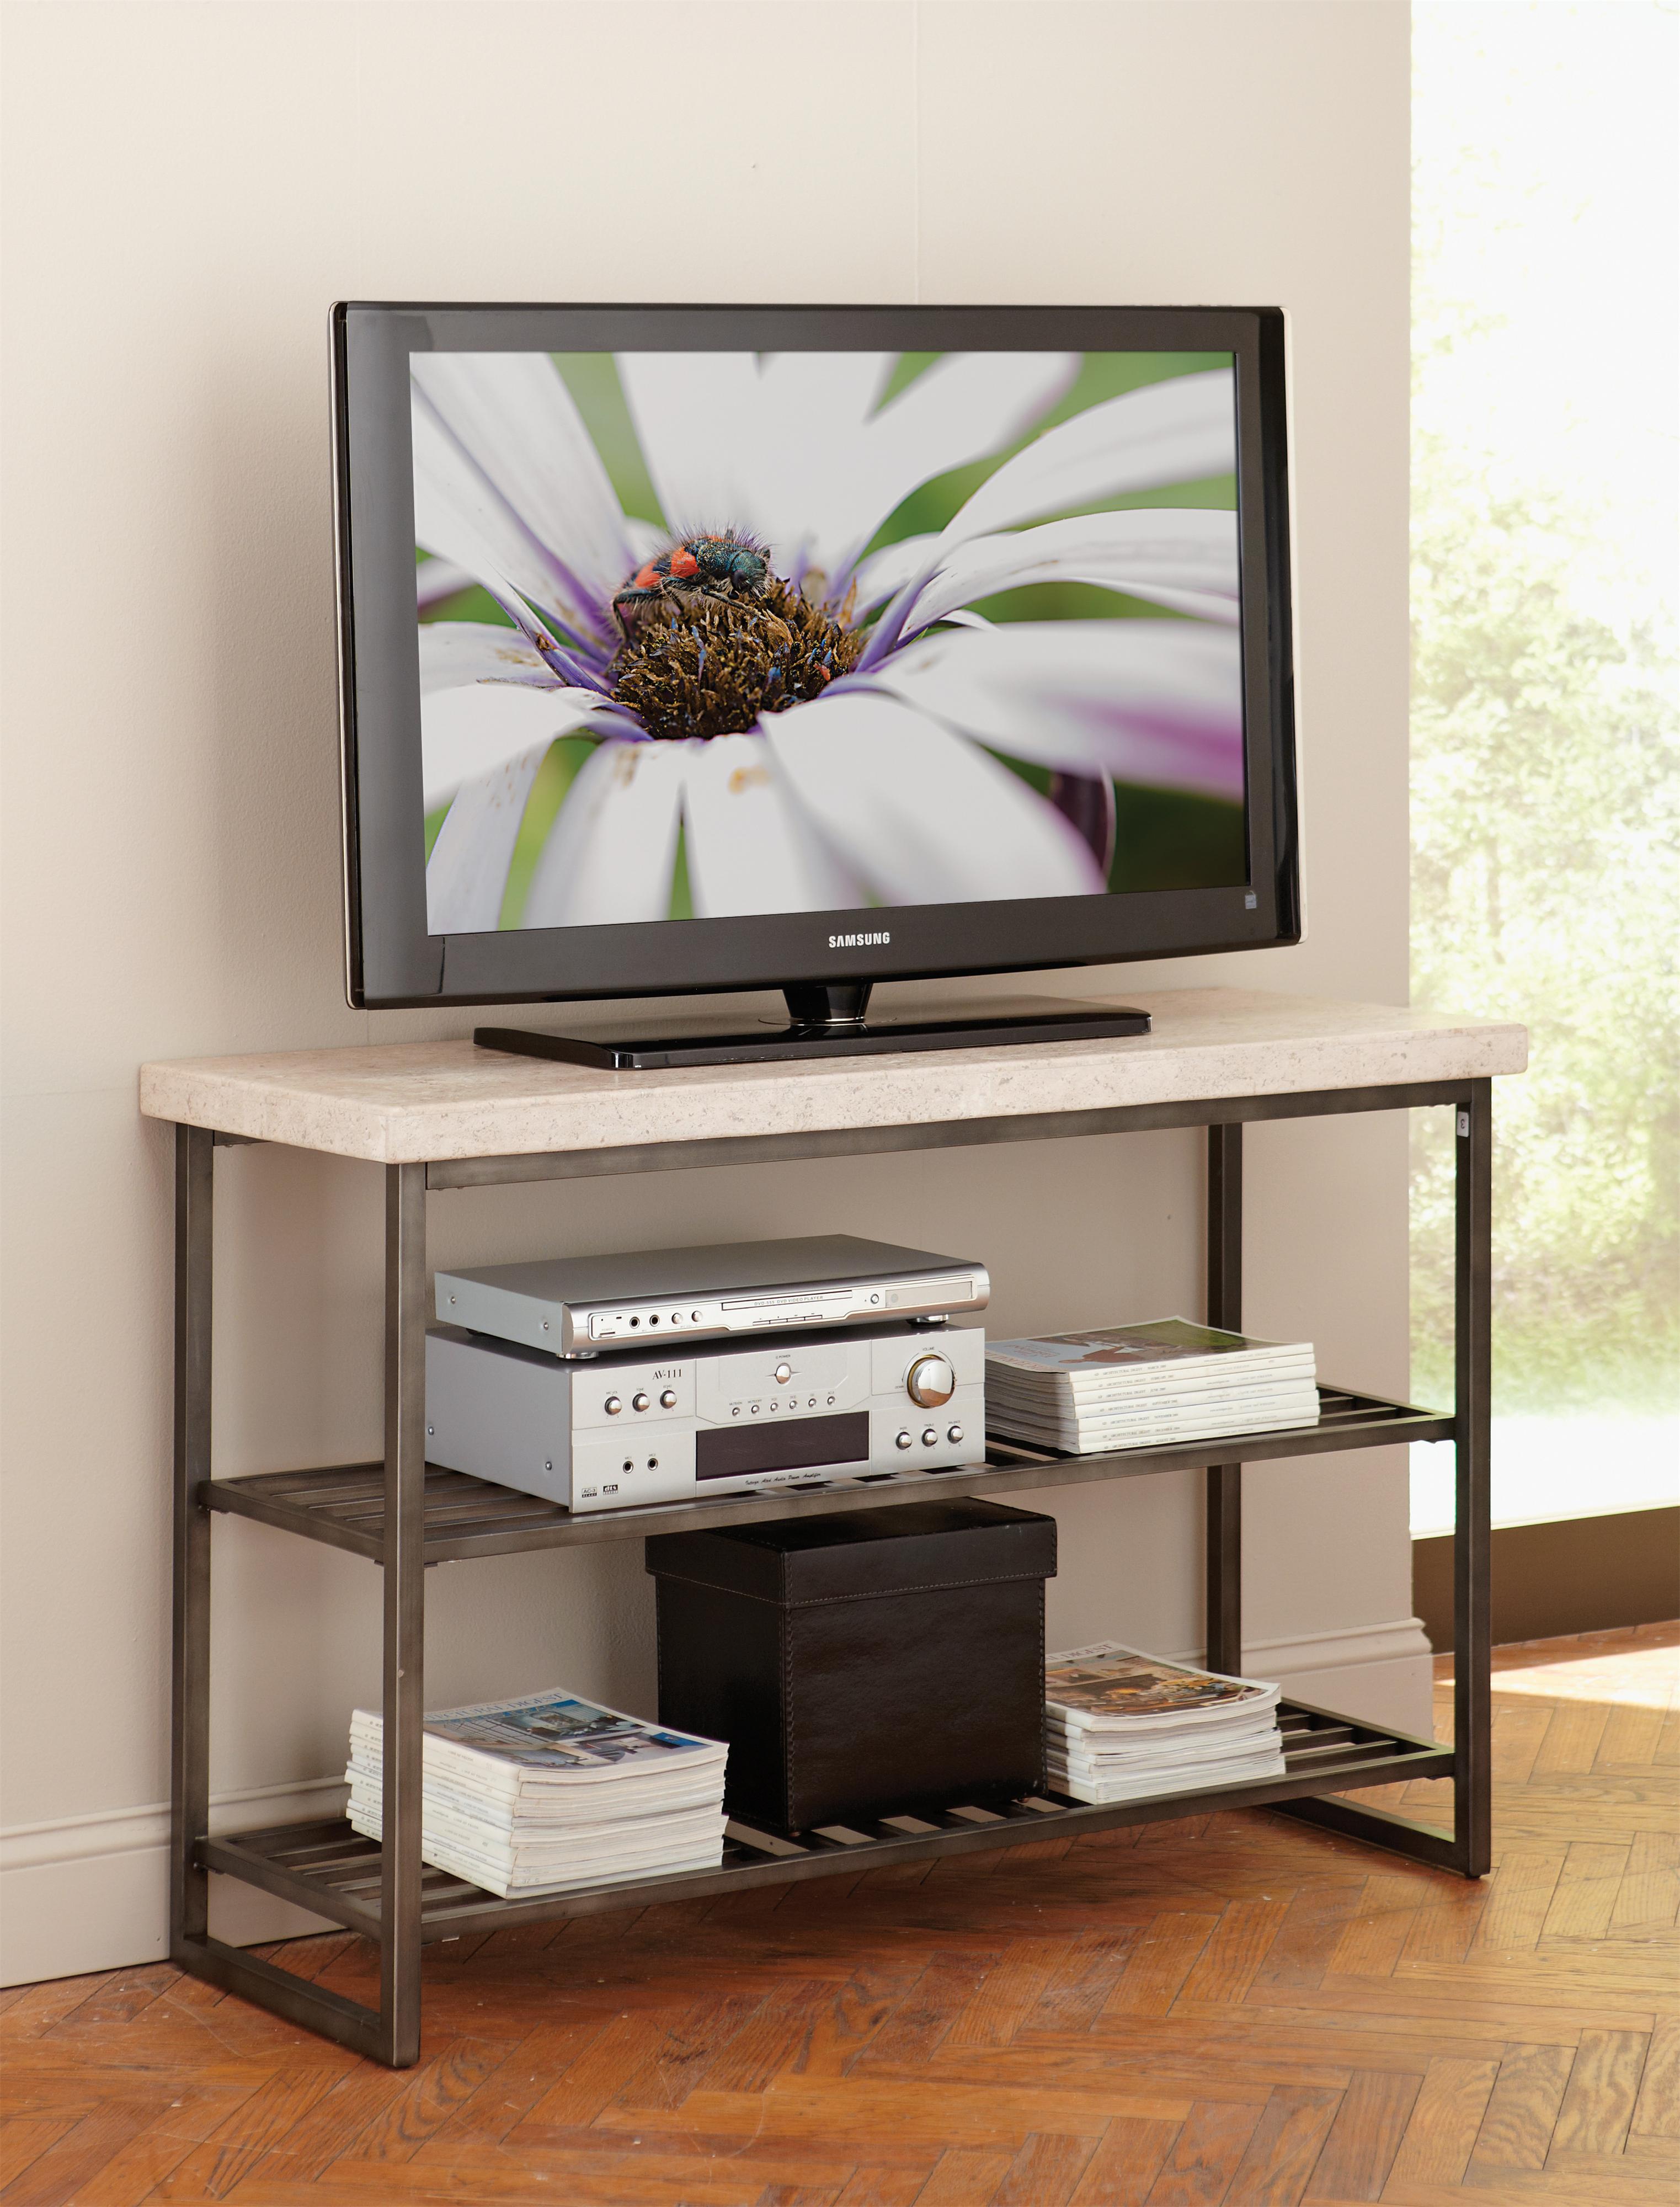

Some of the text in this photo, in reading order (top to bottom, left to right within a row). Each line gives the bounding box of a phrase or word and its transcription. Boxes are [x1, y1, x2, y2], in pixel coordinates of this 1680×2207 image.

[829, 932, 890, 948] SAMSUNG
[653, 1369, 682, 1380] AV-111
[508, 1693, 563, 1709] DIGEST
